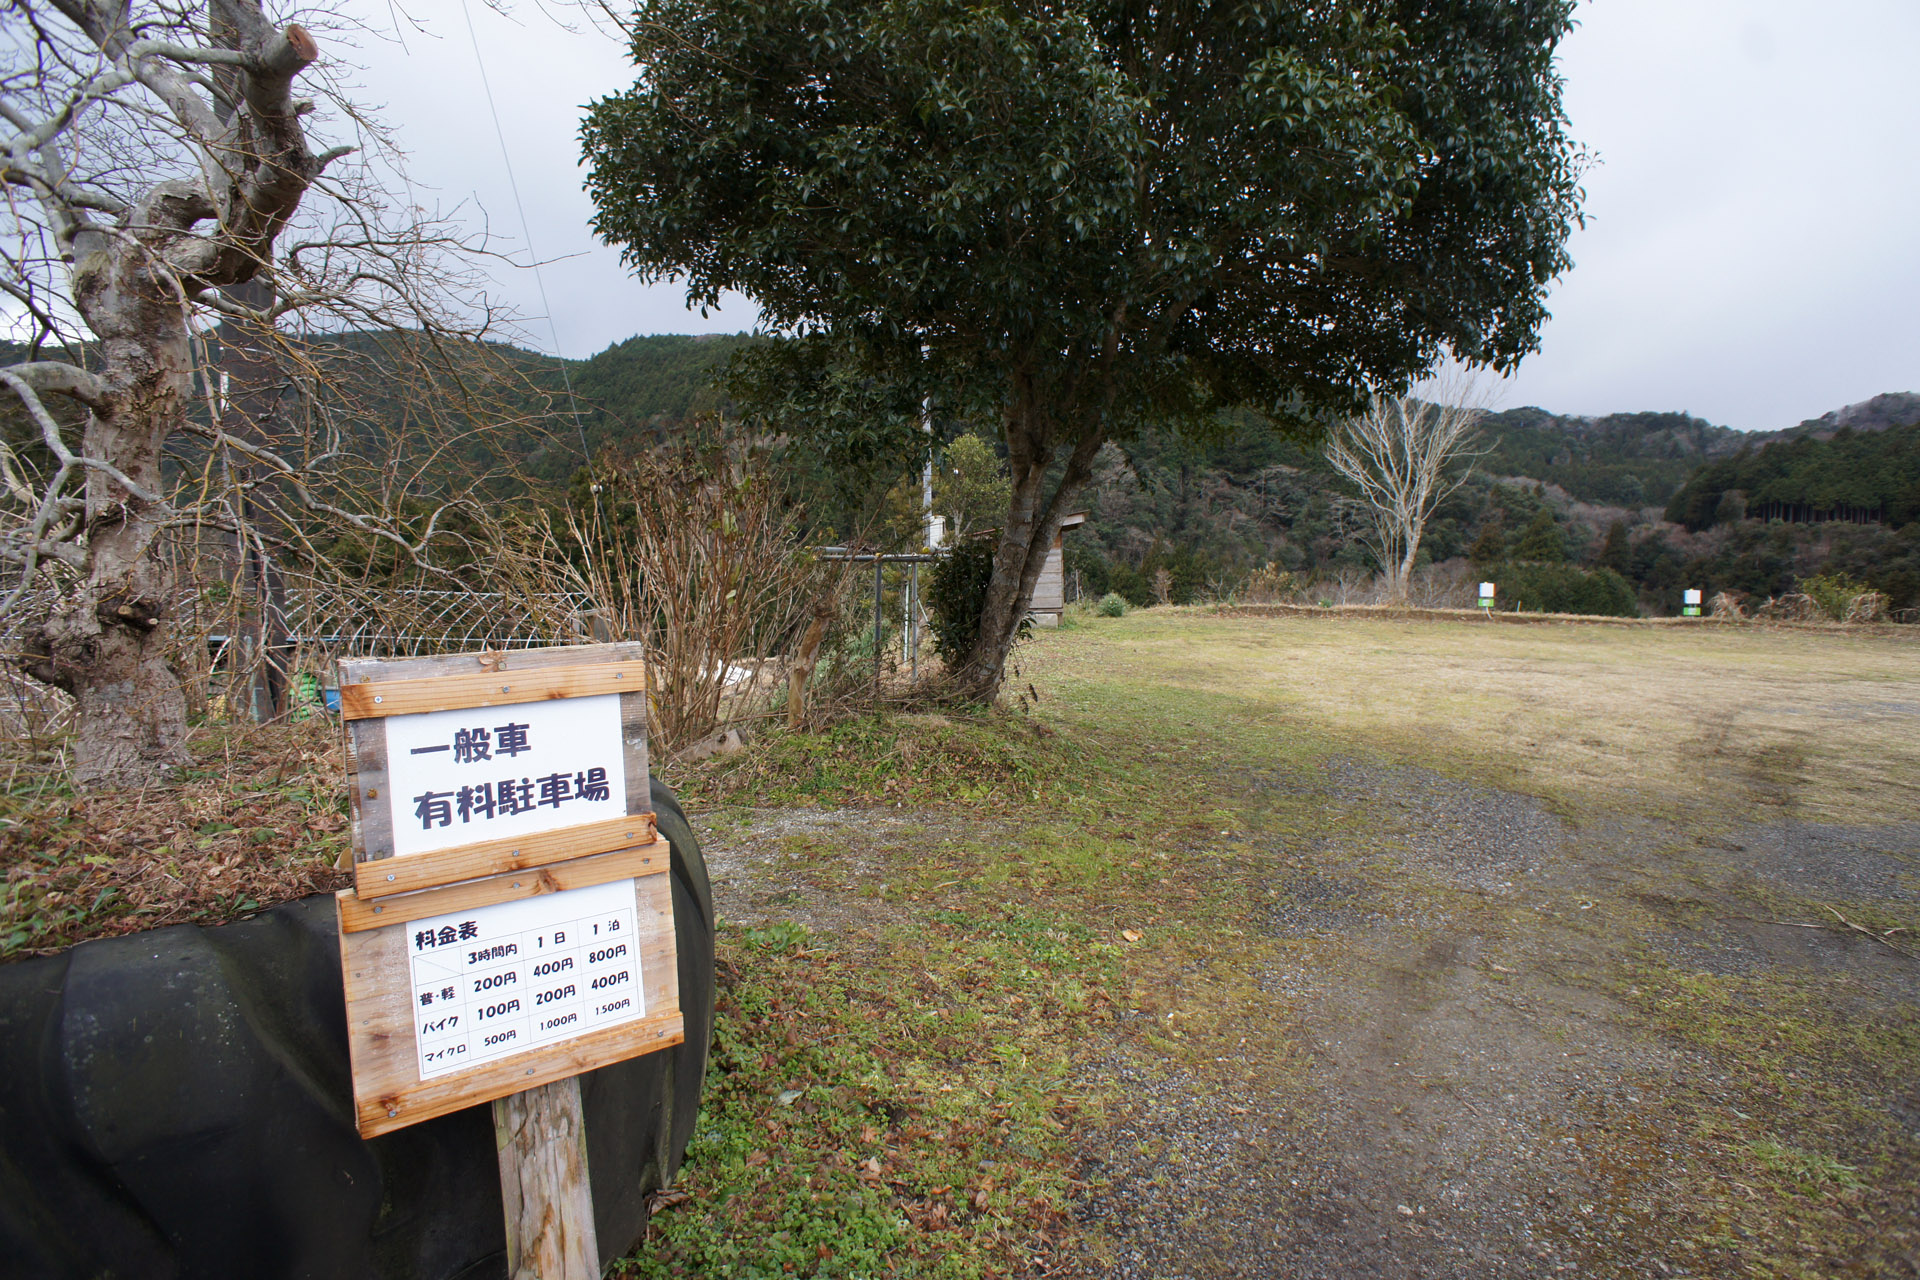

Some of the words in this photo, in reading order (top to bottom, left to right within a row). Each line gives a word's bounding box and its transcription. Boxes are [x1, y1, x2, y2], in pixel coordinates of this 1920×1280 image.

[410, 723, 531, 764] 一般車
[413, 767, 610, 830] 有料駐車場
[416, 921, 478, 950] 料金表
[468, 943, 517, 964] 3時間内
[589, 944, 627, 963] 800円
[533, 958, 573, 977] 400円
[474, 971, 517, 992] 200円
[591, 971, 629, 990] 400円
[420, 986, 455, 1005] 普・軽
[536, 985, 576, 1005] 200円
[478, 999, 520, 1021] 100円
[423, 1016, 459, 1034] バイク
[484, 1030, 516, 1046] 500円
[425, 1044, 466, 1061] マイクロ
